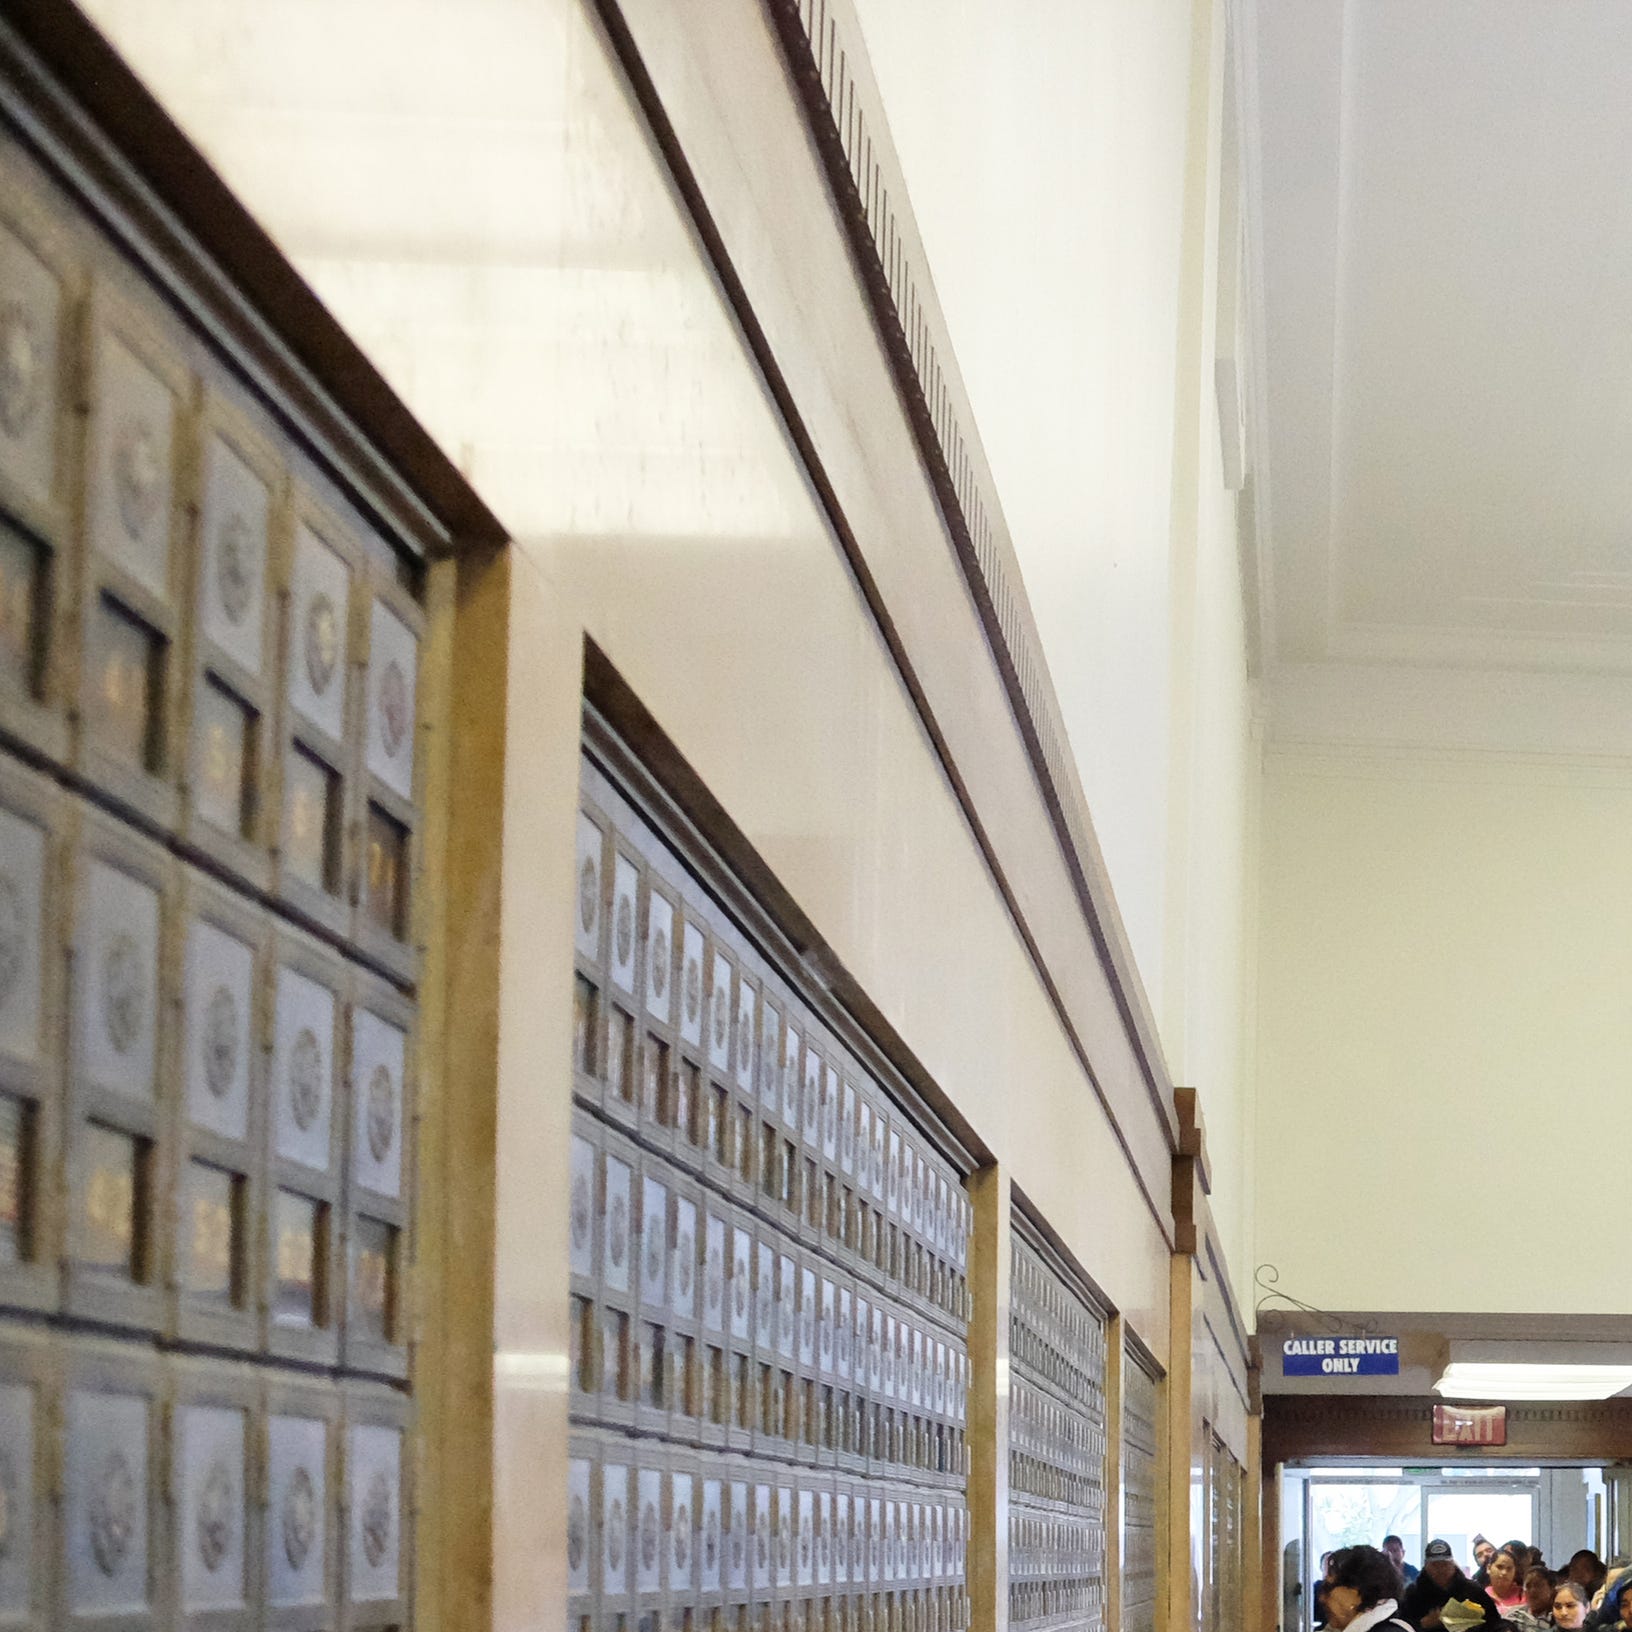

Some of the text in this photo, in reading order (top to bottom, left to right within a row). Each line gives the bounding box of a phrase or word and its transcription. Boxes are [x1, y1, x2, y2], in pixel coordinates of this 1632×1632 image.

[1283, 1339, 1398, 1355] CALLER SERVICE
[1322, 1357, 1360, 1373] ONLY
[1442, 1414, 1498, 1441] EXIT
